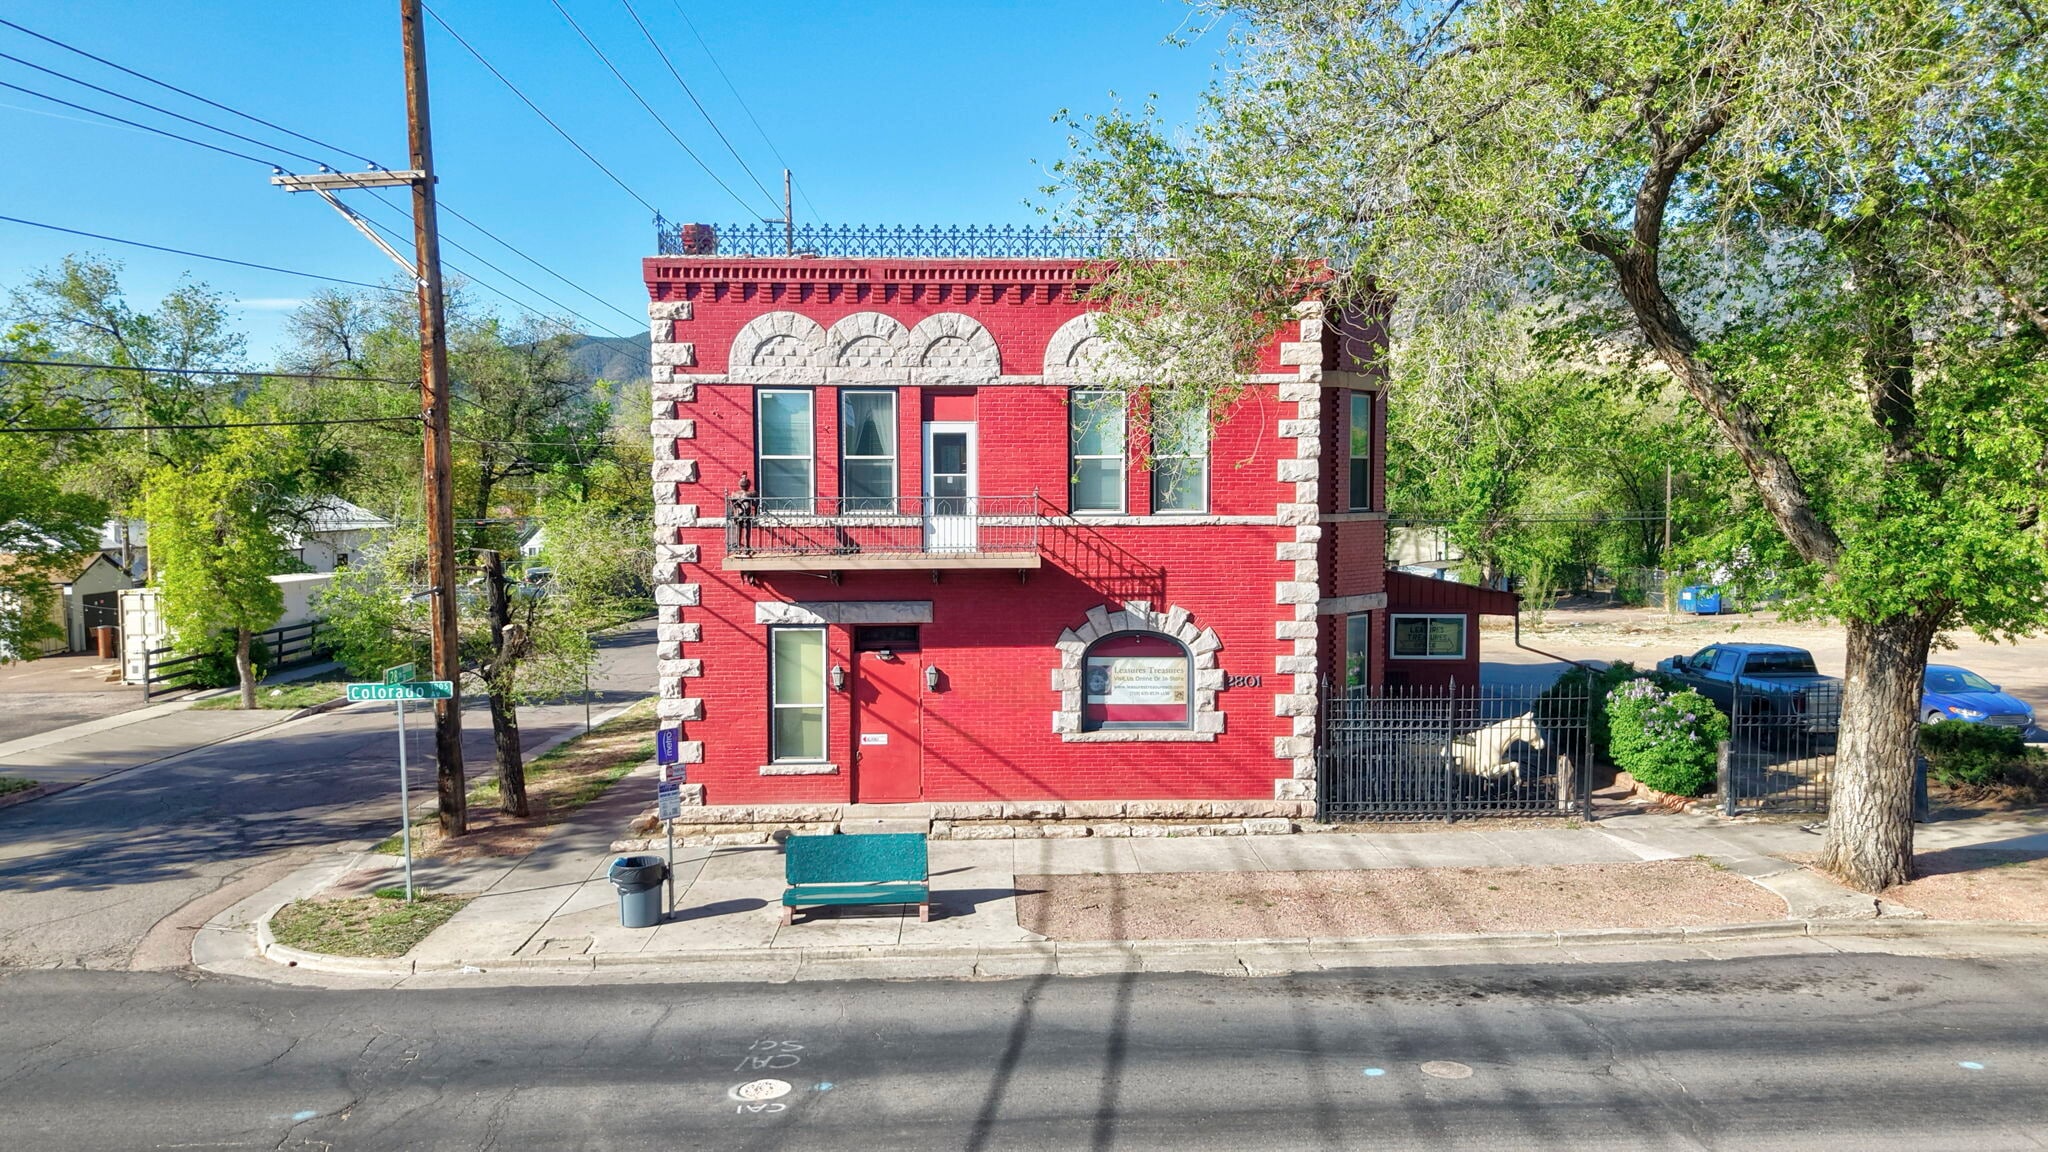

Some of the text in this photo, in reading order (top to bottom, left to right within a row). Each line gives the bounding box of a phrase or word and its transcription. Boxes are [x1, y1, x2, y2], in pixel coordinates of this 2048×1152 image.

[1228, 675, 1262, 687] 2801
[351, 684, 425, 699] Colorado
[665, 731, 673, 757] metro
